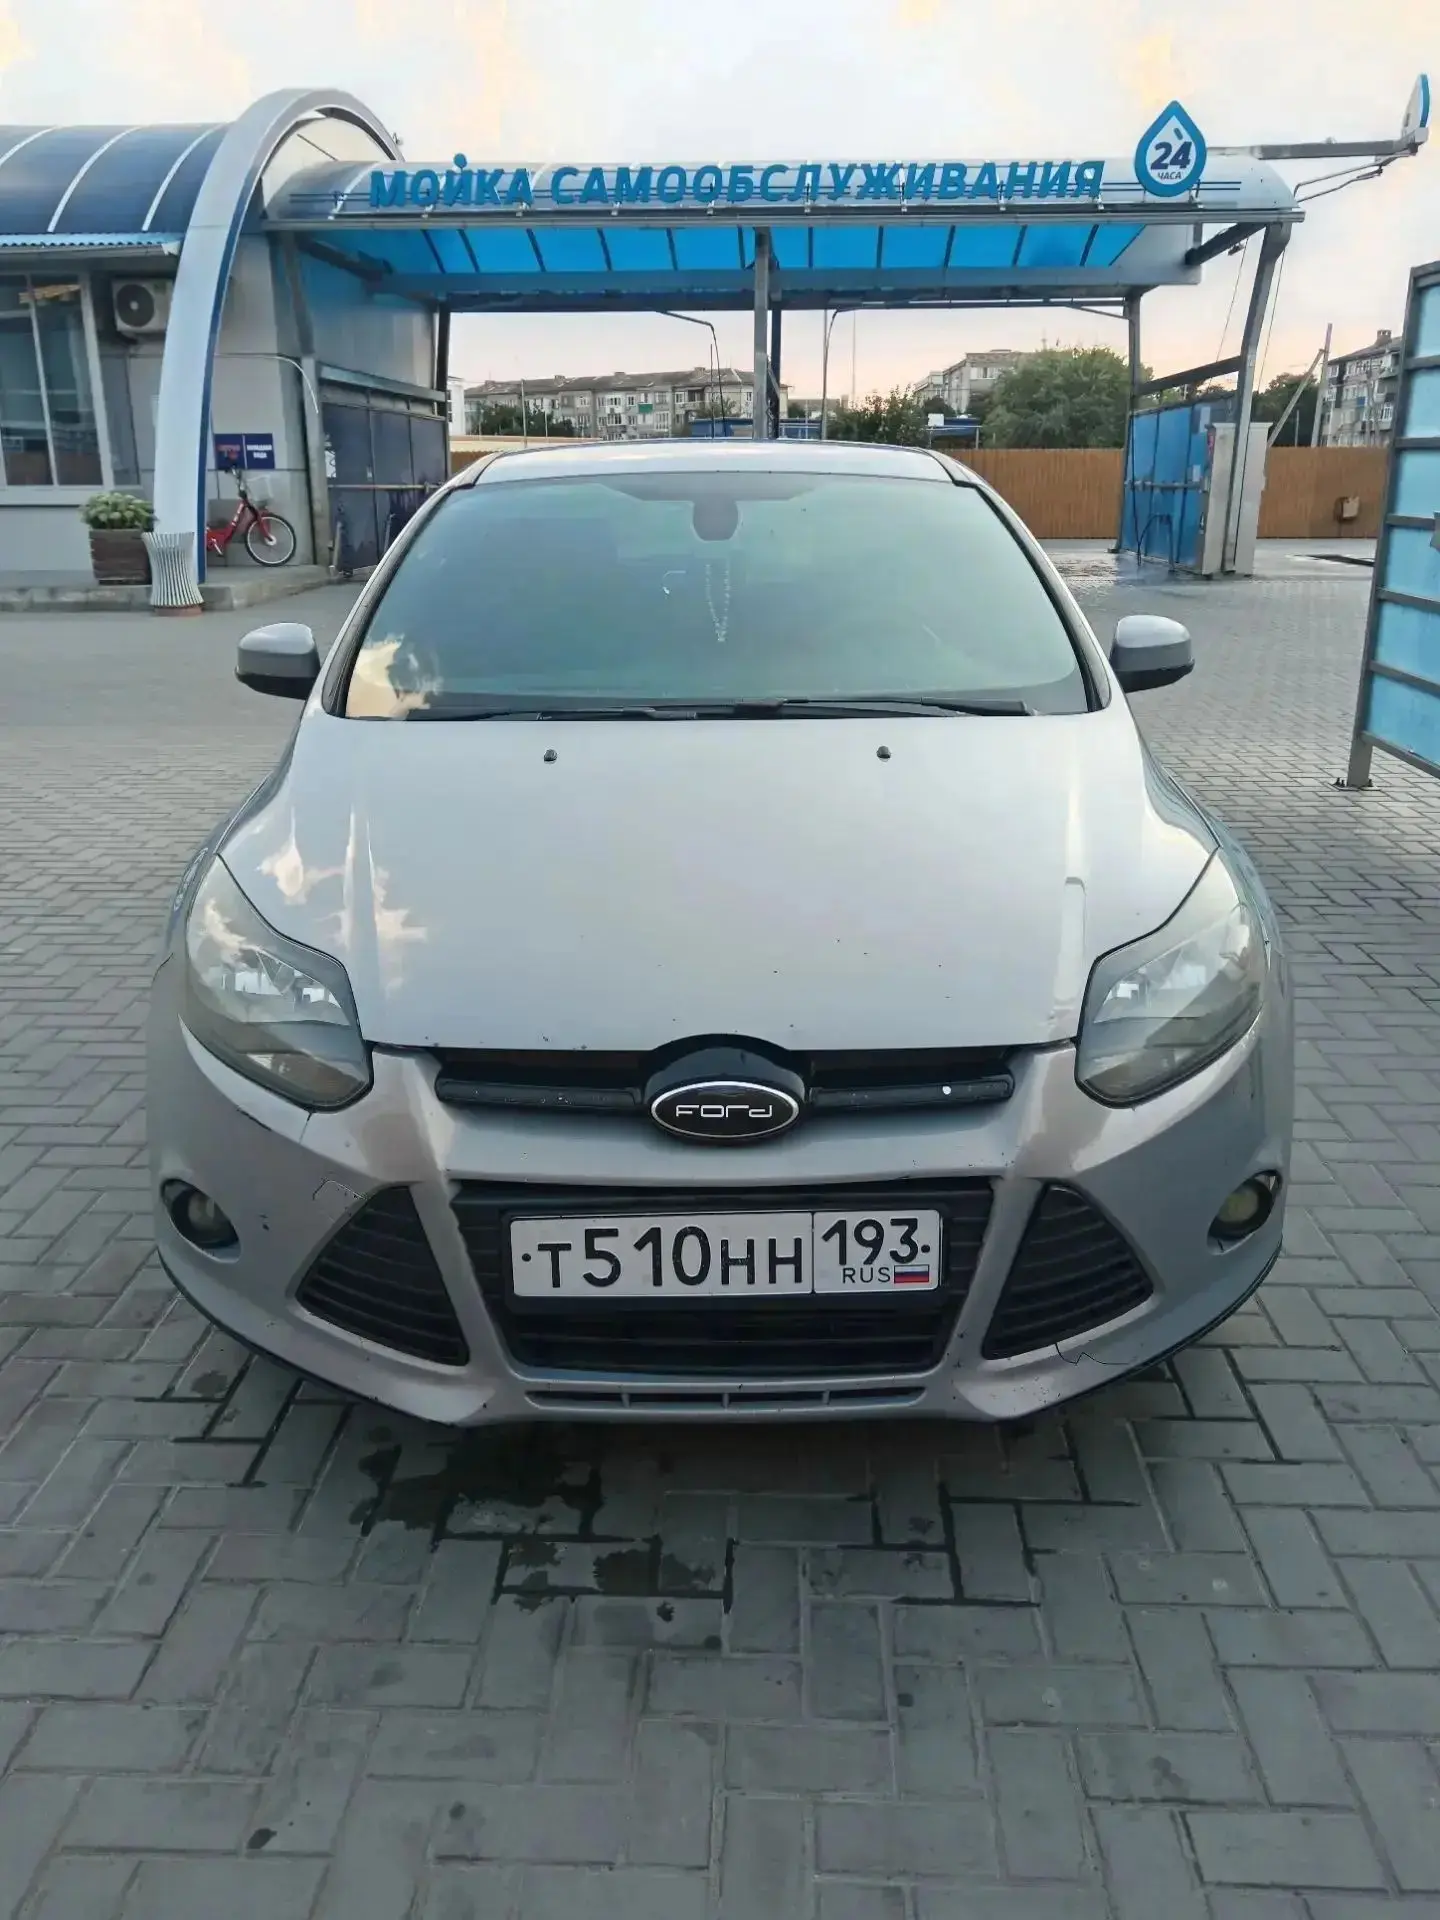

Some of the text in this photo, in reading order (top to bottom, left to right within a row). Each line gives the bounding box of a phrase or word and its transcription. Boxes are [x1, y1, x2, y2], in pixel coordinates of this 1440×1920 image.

[1150, 141, 1193, 170] 24
[370, 153, 1105, 207] МОЙКА САМООБСЛУЖИВАНИЯ
[1157, 171, 1182, 180] ЧАСА
[821, 1218, 919, 1265] 193
[842, 1266, 891, 1284] RUS
